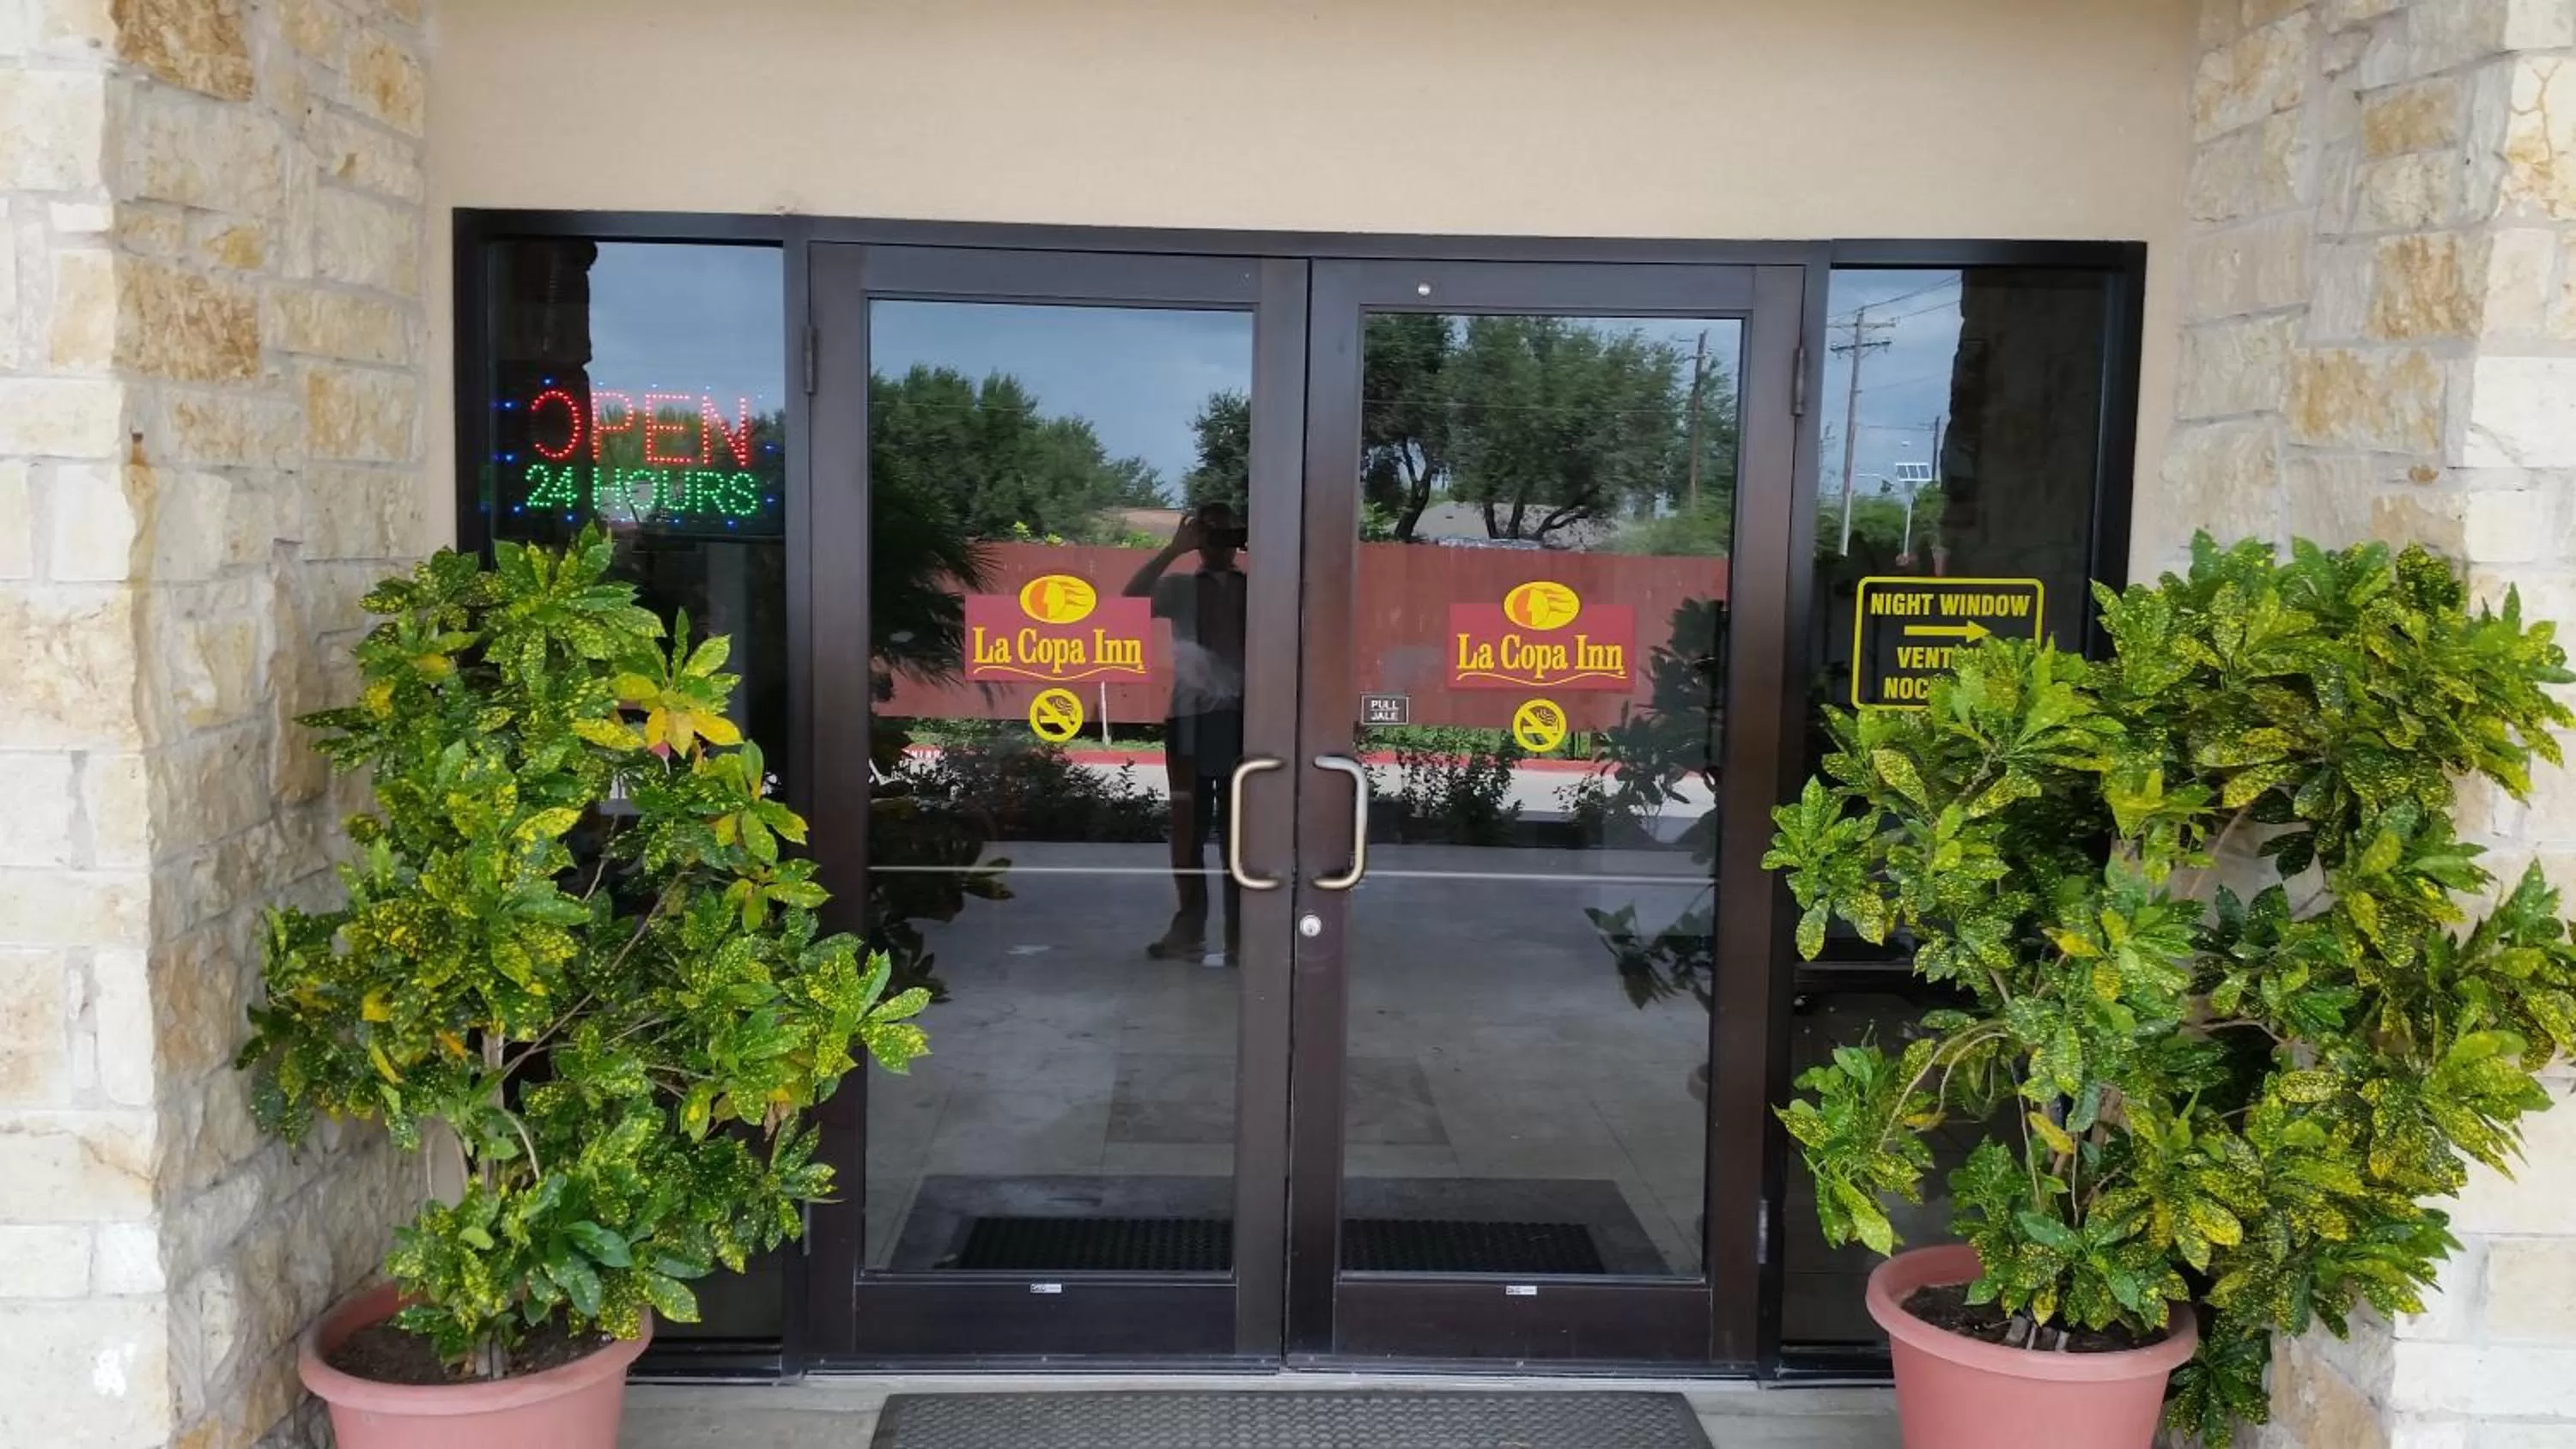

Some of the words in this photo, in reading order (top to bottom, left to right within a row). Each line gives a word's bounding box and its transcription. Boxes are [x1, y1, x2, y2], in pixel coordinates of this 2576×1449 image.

[525, 464, 578, 508] 24
[592, 466, 759, 515] HOURS
[1869, 592, 1935, 615] NIGHT
[1939, 593, 2032, 617] WINDOW
[972, 627, 1012, 664] La
[1017, 627, 1086, 674] Copa
[1092, 628, 1145, 665] Inn
[1456, 633, 1495, 670] La
[1500, 634, 1568, 679] Copa
[1573, 634, 1625, 672] Inn
[1897, 646, 1982, 670] VENT
[1370, 700, 1399, 710] PULL
